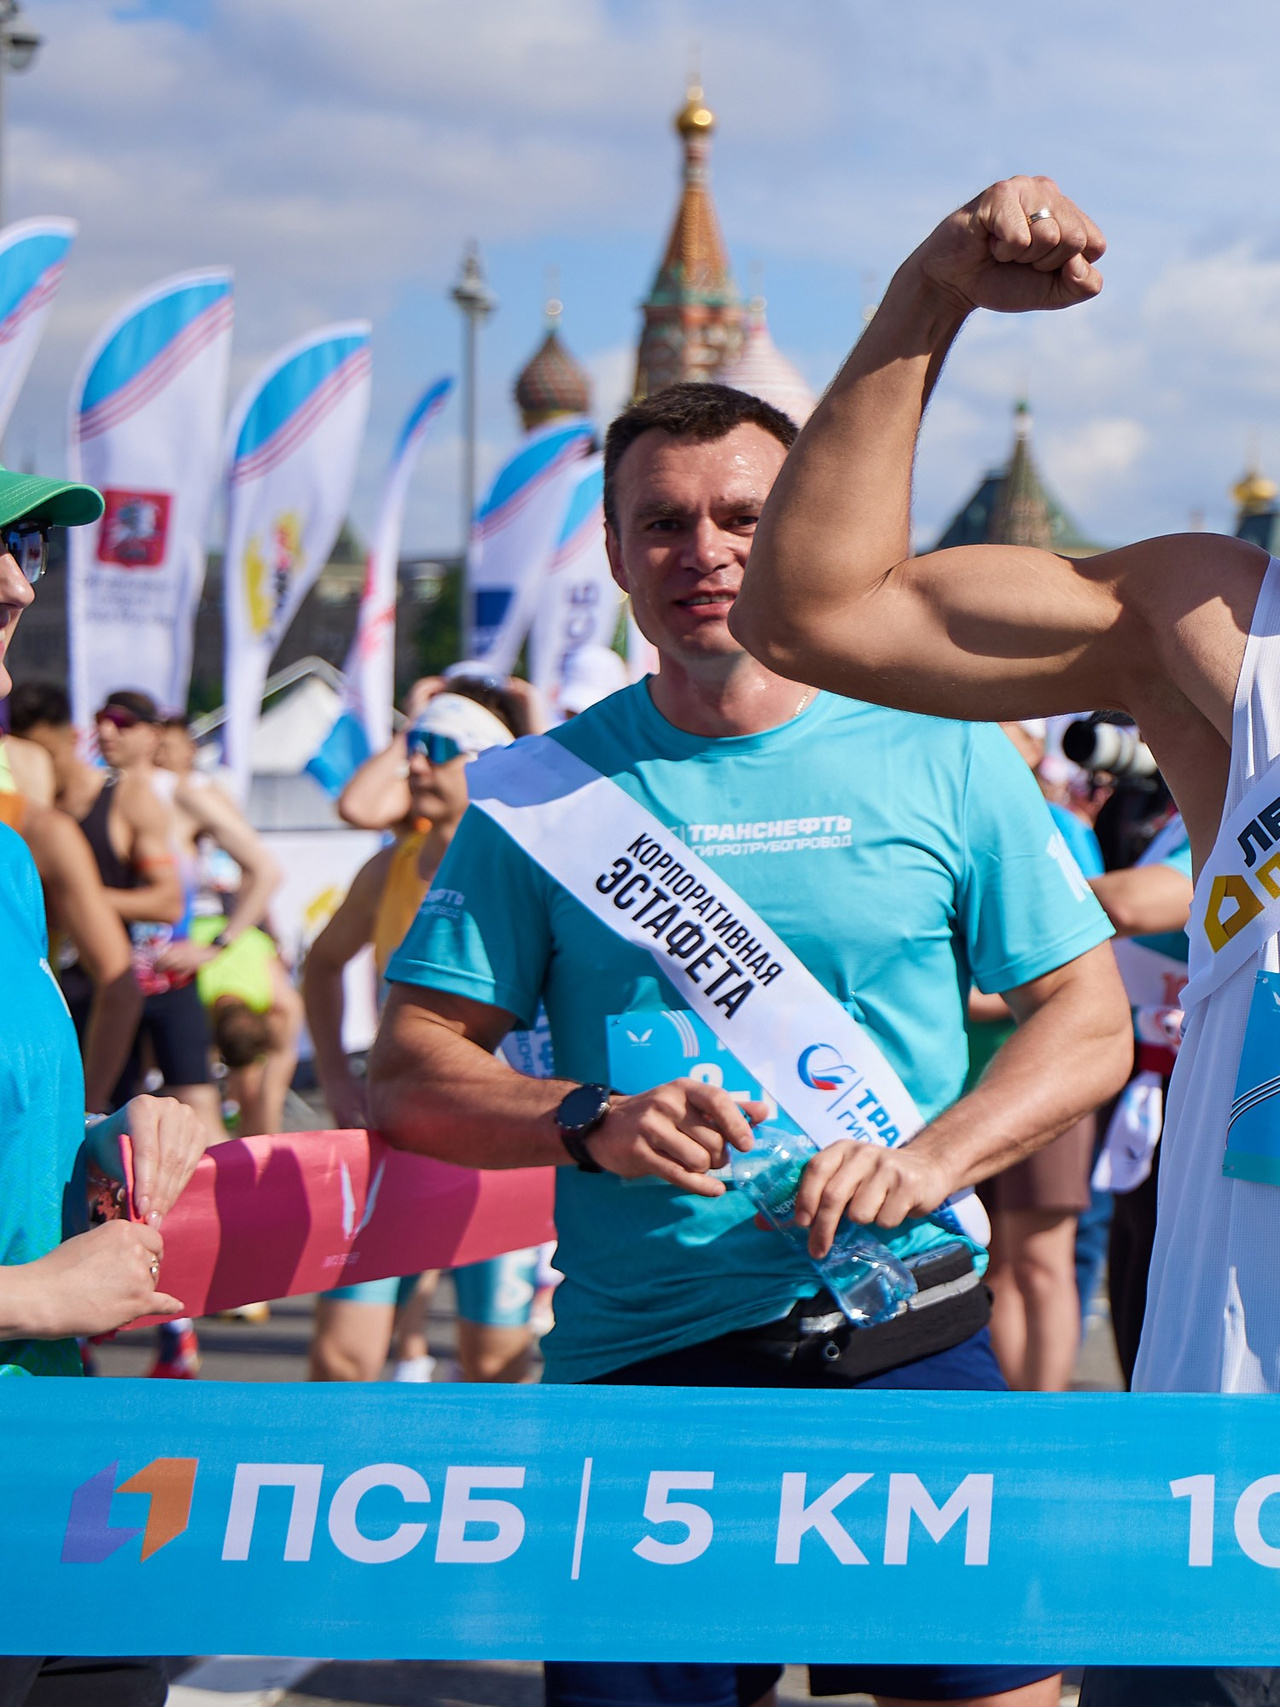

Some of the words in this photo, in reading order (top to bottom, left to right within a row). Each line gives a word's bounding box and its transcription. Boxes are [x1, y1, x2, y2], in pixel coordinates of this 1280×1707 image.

[689, 815, 853, 843] ТРАНСНЕФТЬ
[595, 856, 756, 1020] ЭСТАФЕТА
[627, 832, 784, 987] КОРПОРАТИВНАЯ
[221, 1463, 526, 1565] ПСБ
[632, 1471, 714, 1565] 5
[774, 1472, 995, 1566] КМ
